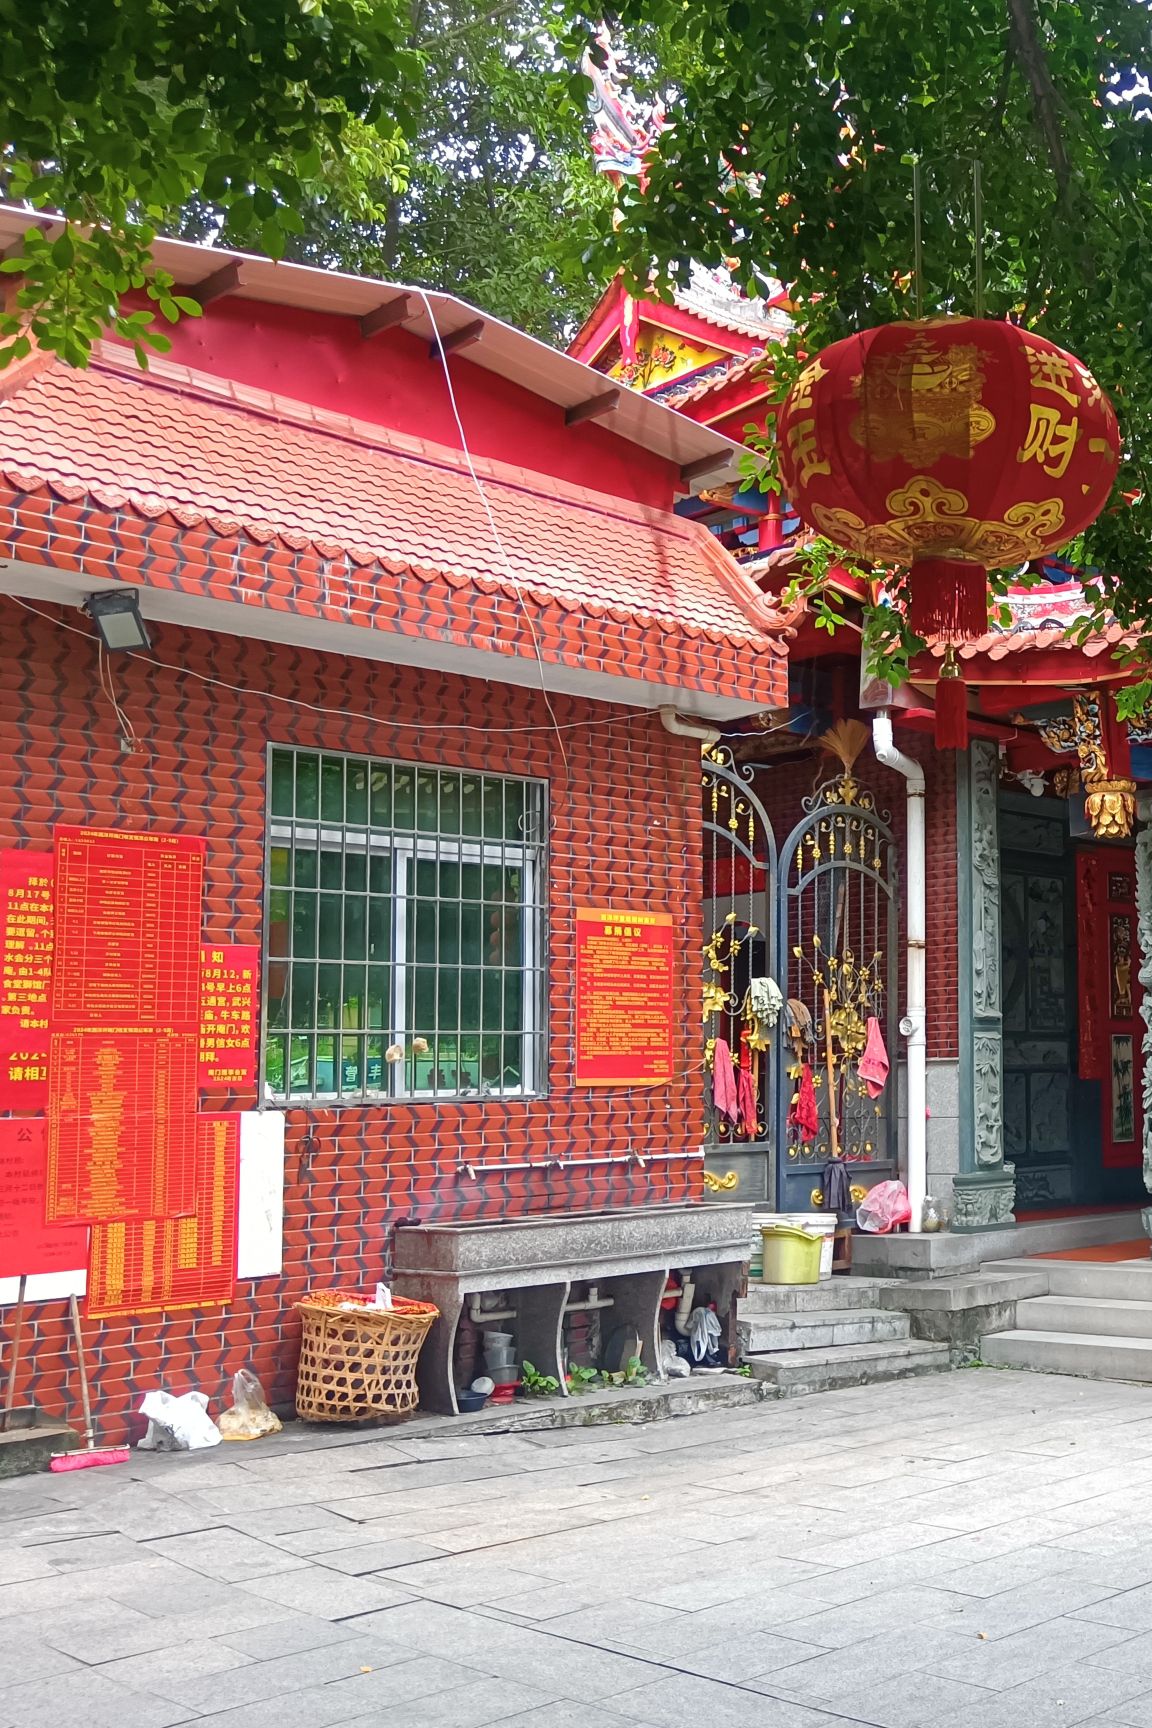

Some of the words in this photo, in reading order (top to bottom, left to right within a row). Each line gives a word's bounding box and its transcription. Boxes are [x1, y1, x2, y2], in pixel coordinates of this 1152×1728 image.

[1018, 346, 1085, 479] 进财
[788, 358, 831, 487] 金玉
[7, 889, 51, 901] 8月17号
[201, 968, 252, 980] 8月12，新
[201, 1010, 251, 1021] 庙，牛车路
